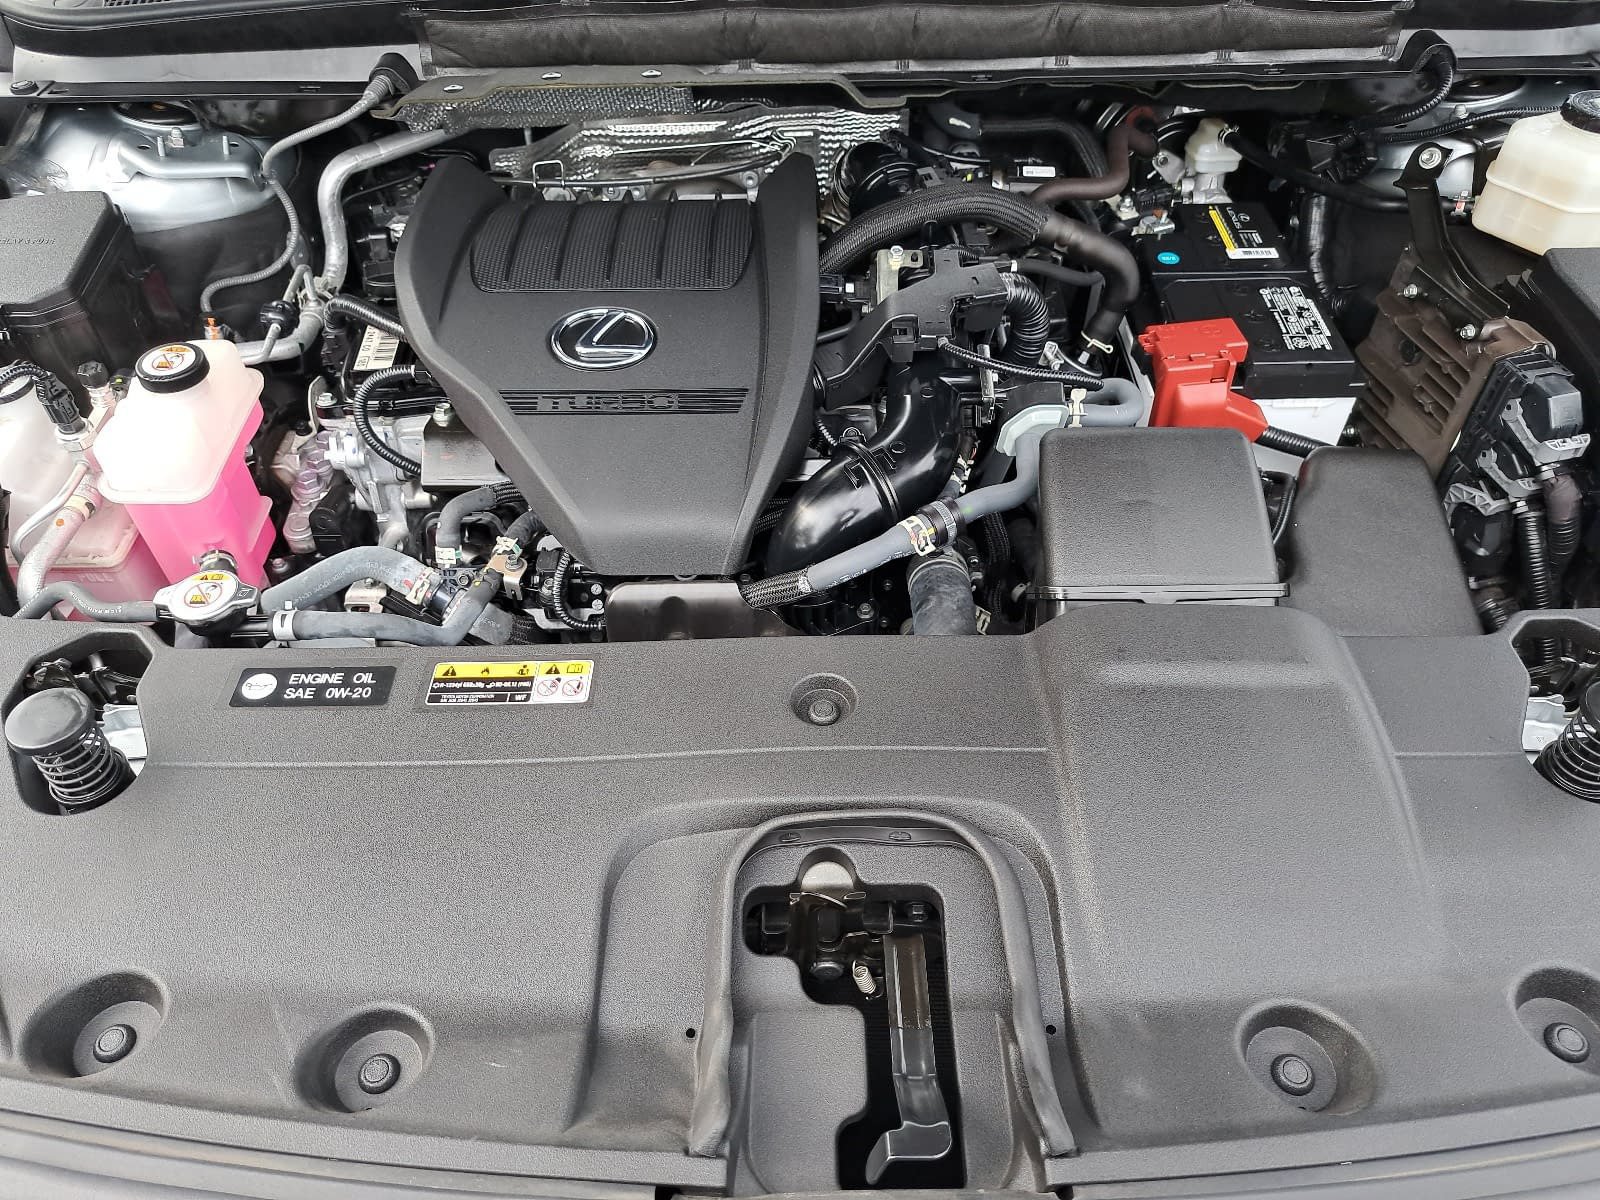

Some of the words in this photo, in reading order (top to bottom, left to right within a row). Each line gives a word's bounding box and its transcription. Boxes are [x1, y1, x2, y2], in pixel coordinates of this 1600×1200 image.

[540, 394, 679, 411] TURBO
[288, 672, 345, 685] ENGINE
[353, 672, 377, 684] OIL
[283, 687, 317, 699] SAE
[325, 686, 372, 698] 0W-20
